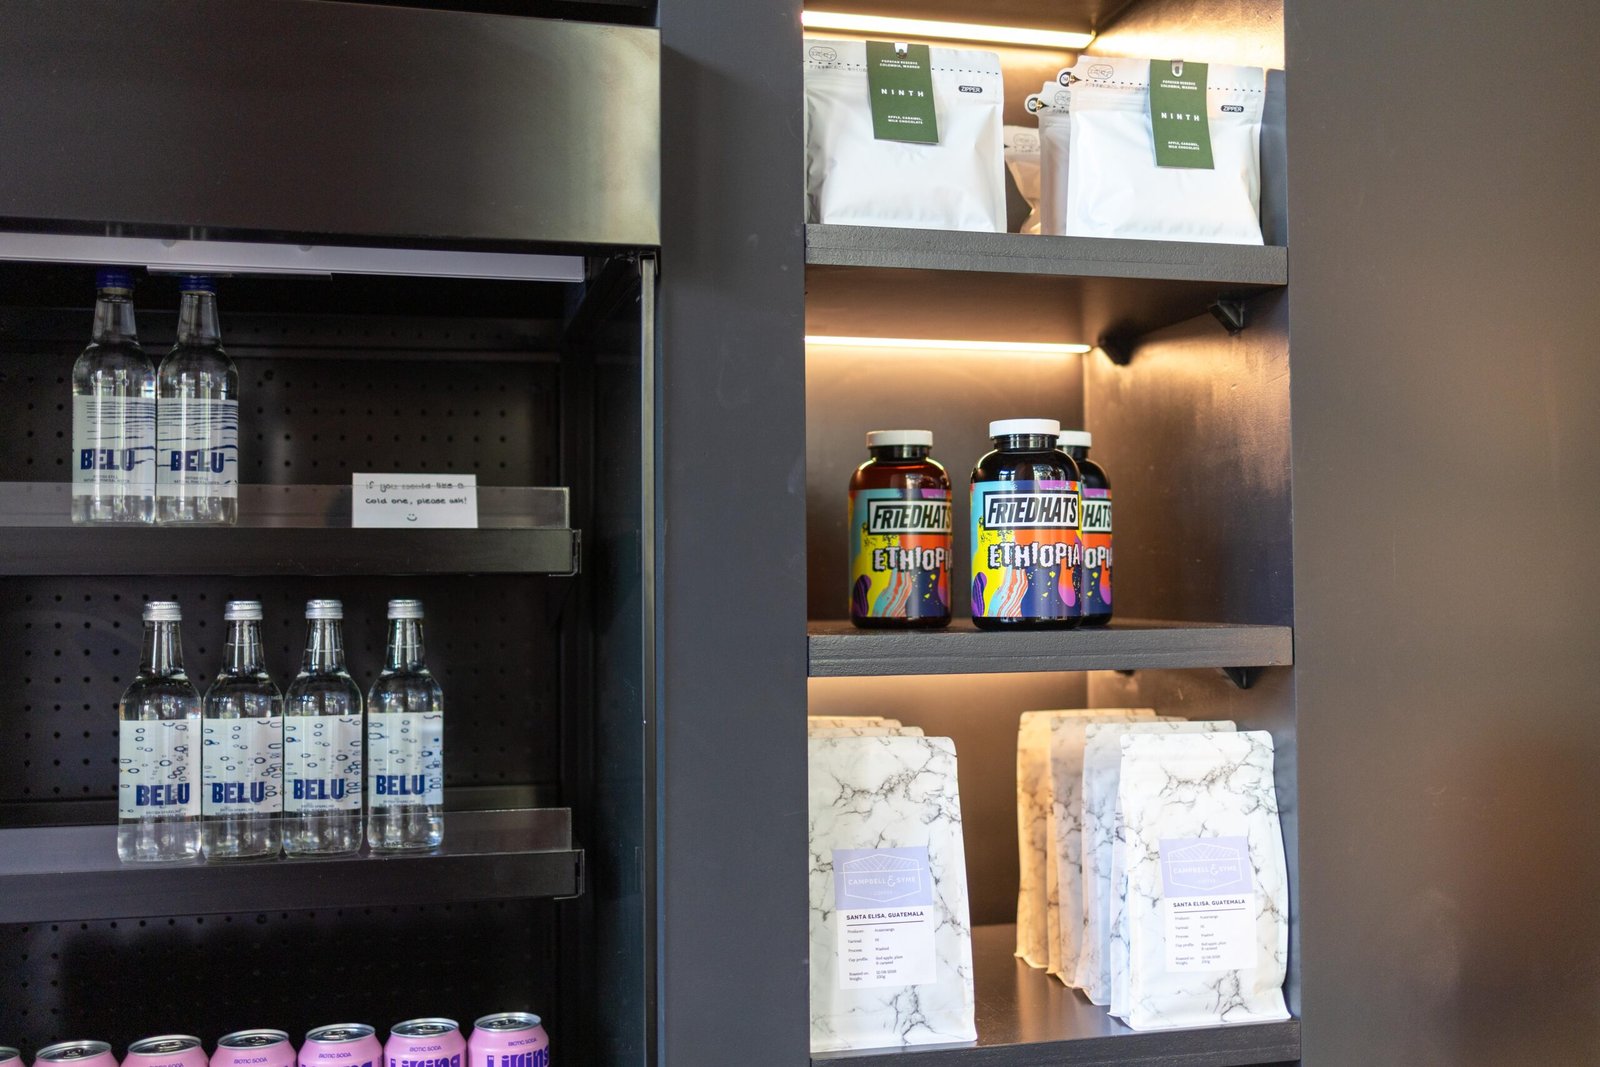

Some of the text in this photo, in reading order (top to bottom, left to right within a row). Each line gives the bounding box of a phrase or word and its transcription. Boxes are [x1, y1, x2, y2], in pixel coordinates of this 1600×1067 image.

[881, 88, 924, 97] NINTH
[1161, 112, 1200, 121] NINTH
[80, 448, 135, 471] BELU
[170, 450, 224, 473] BELU
[380, 482, 398, 492] you
[873, 504, 951, 529] FRIEDHATS
[988, 496, 1077, 524] FRIEDHATS
[1082, 504, 1112, 528] HATS
[988, 542, 1081, 568] ETHIOPIA
[136, 782, 190, 806] BELU
[212, 782, 264, 804] BELU
[293, 778, 344, 800] BELU
[376, 774, 425, 796] BELU
